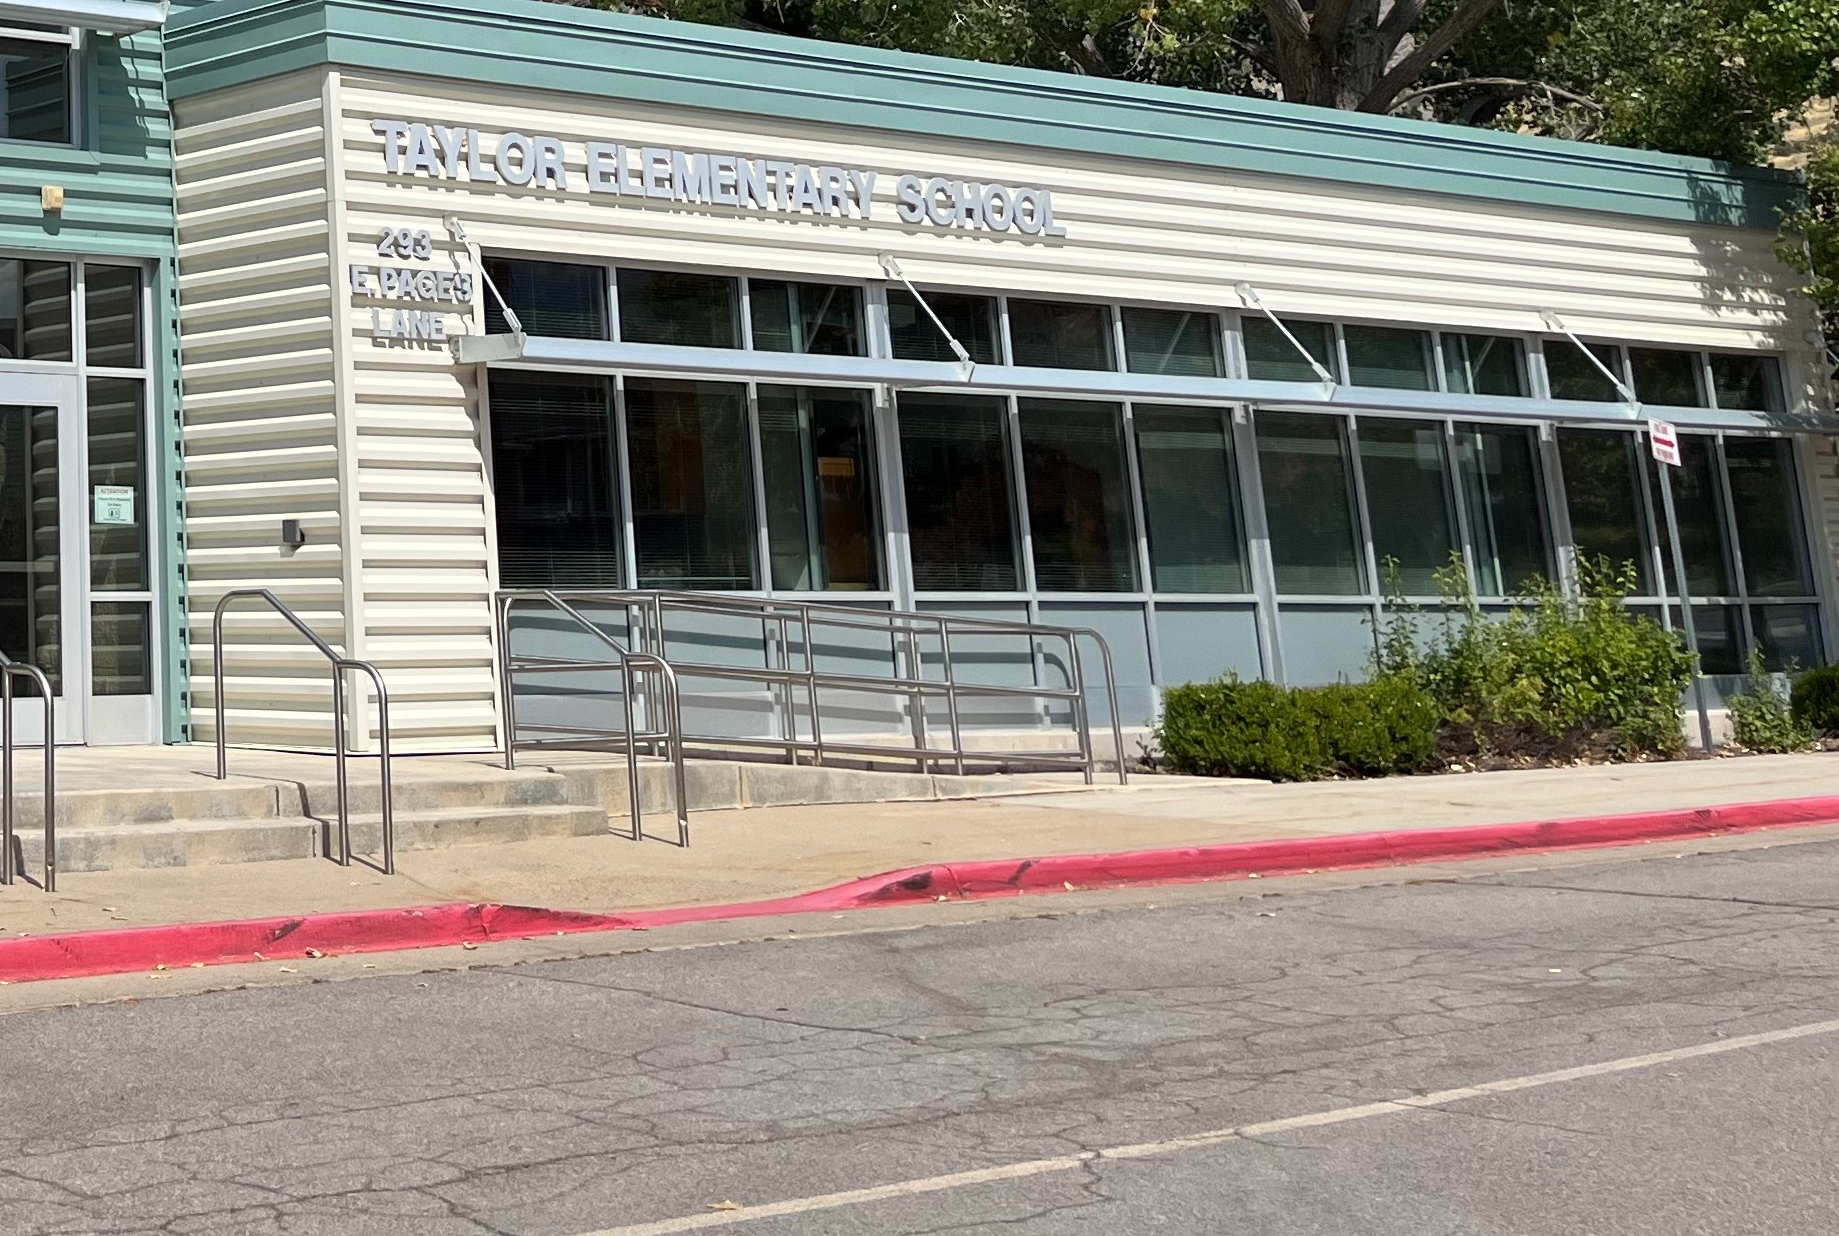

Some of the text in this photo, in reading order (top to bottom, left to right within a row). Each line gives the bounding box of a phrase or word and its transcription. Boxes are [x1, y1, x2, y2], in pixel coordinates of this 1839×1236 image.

[371, 119, 1066, 238] TAYLOR ELEMENTARY SCHOOL
[378, 227, 433, 258] 293
[380, 268, 473, 302] PAGES
[372, 308, 447, 341] LANE
